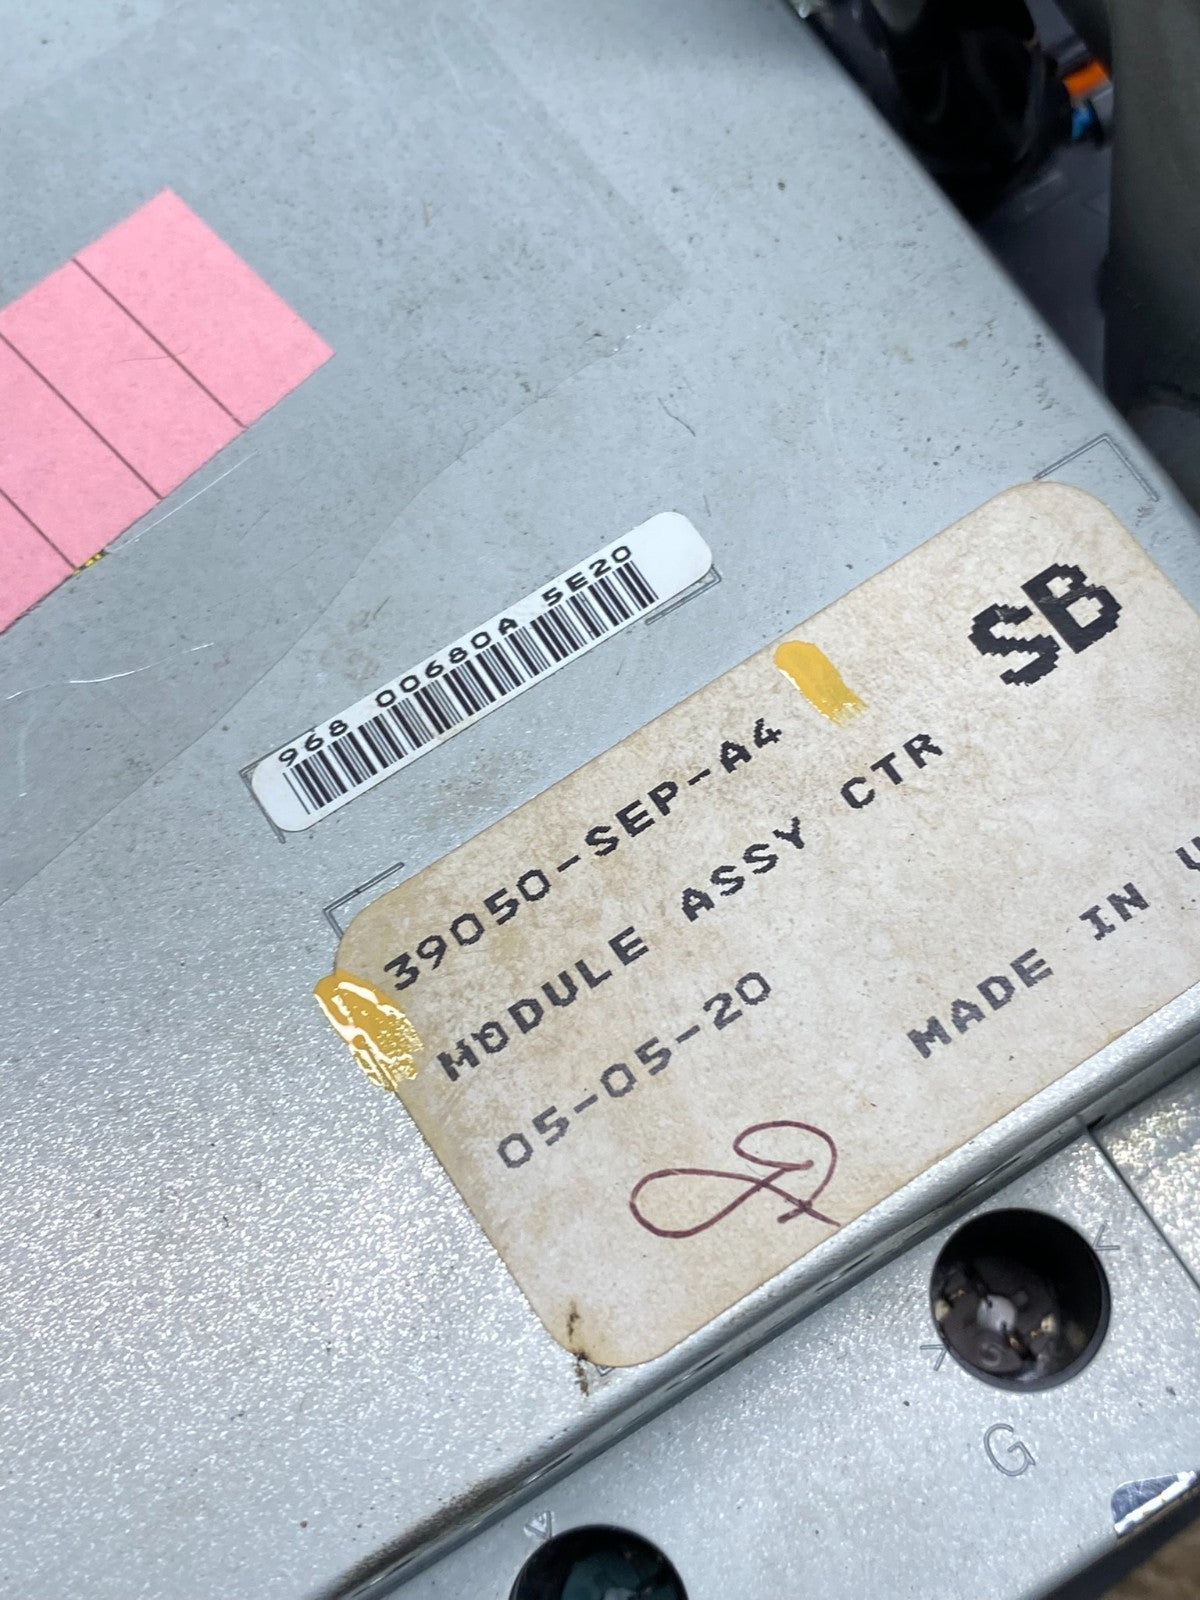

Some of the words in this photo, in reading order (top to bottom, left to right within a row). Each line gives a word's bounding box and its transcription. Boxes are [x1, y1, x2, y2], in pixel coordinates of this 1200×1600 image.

[278, 719, 349, 768] 968
[375, 617, 519, 708] 00680A
[541, 544, 633, 608] 5E20
[968, 562, 1123, 687] SB
[383, 717, 783, 991] 39050-SEP-A4
[436, 925, 650, 1083] MODULE
[681, 816, 806, 922] ASSY
[840, 733, 944, 809] CTR
[906, 947, 1054, 1060] MADE
[1078, 881, 1150, 941] IN
[498, 971, 773, 1169] 05-05-20
[982, 1422, 1036, 1477] G
